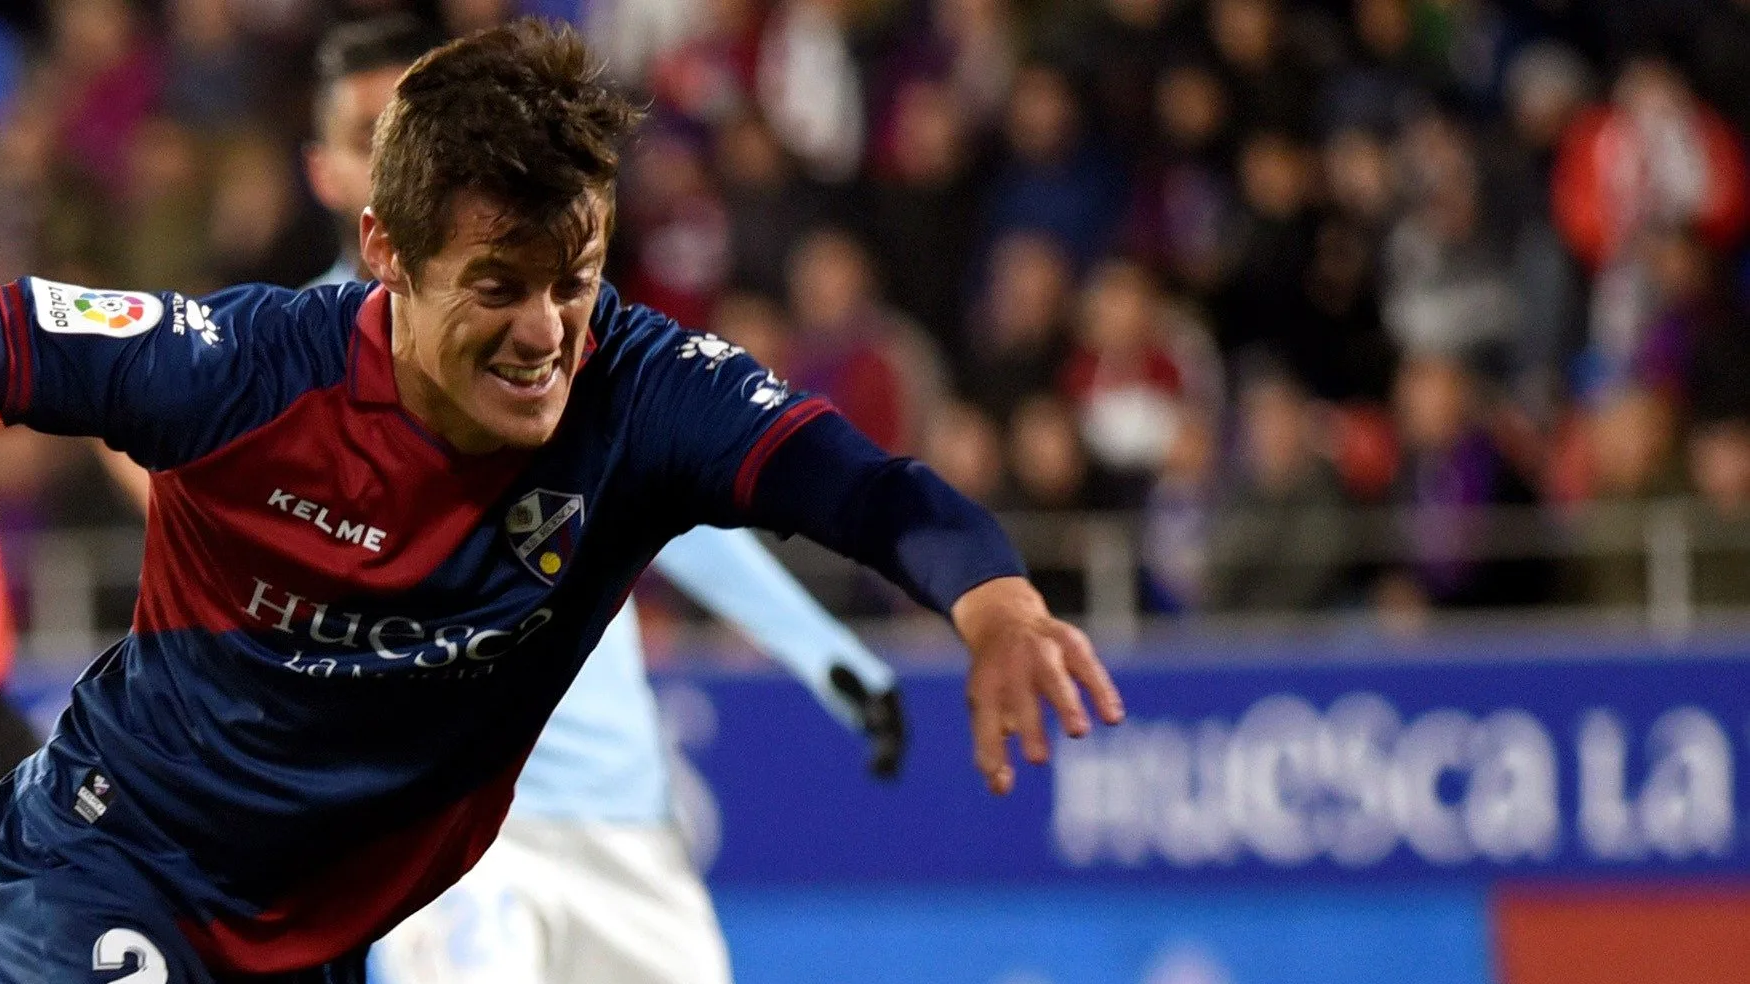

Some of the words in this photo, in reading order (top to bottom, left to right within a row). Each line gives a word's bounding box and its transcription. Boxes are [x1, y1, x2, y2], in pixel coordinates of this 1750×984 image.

[49, 286, 69, 328] LaLiga
[172, 291, 186, 336] ELME
[267, 488, 387, 552] KELME
[244, 576, 553, 669] Huesca
